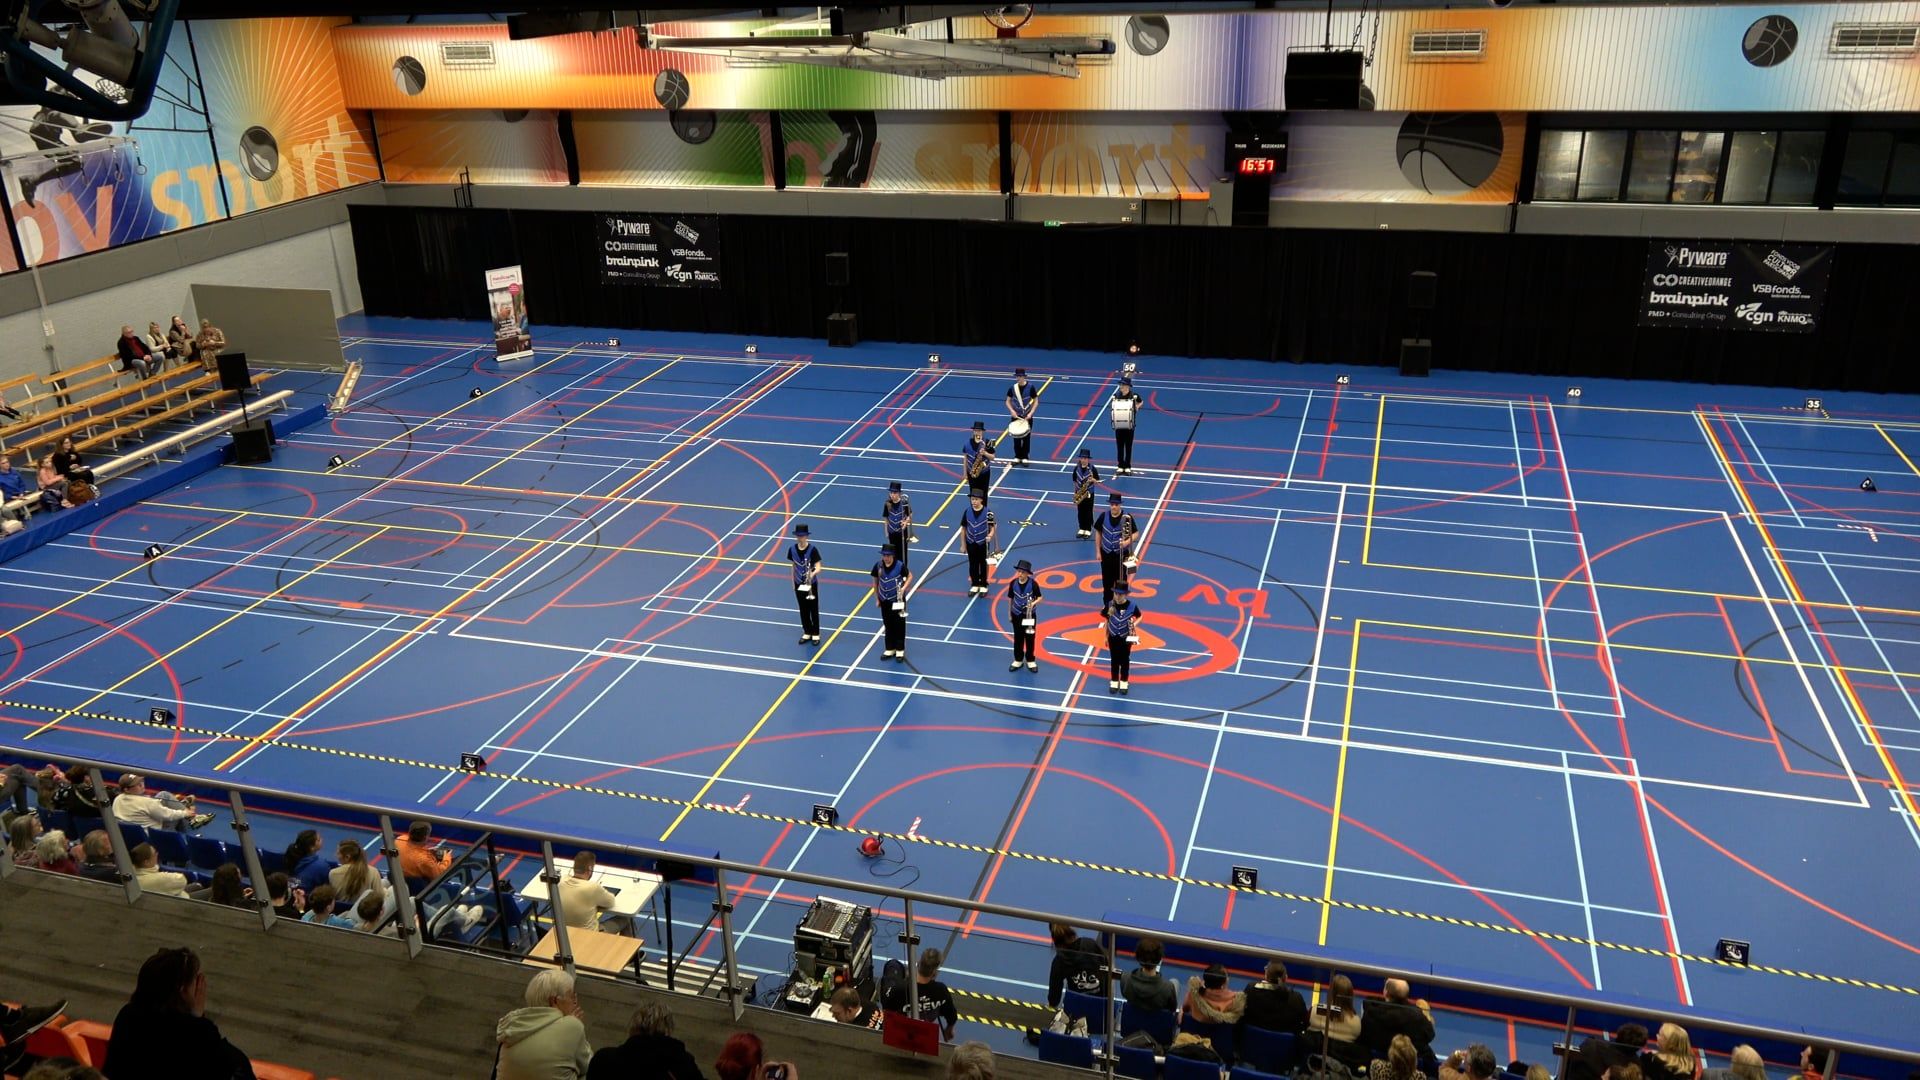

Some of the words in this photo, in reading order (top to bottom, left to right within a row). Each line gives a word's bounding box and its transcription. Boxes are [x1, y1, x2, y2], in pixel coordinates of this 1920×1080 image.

[1241, 160, 1274, 171] 16:57
[617, 220, 650, 235] Pyware
[606, 255, 659, 268] brainpink
[1679, 248, 1727, 267] Pyware
[674, 272, 692, 282] cgn
[1653, 274, 1678, 286] CO
[1650, 291, 1729, 306] brainpink
[1746, 312, 1774, 324] cgn
[1124, 364, 1135, 372] 50
[152, 547, 160, 556] A
